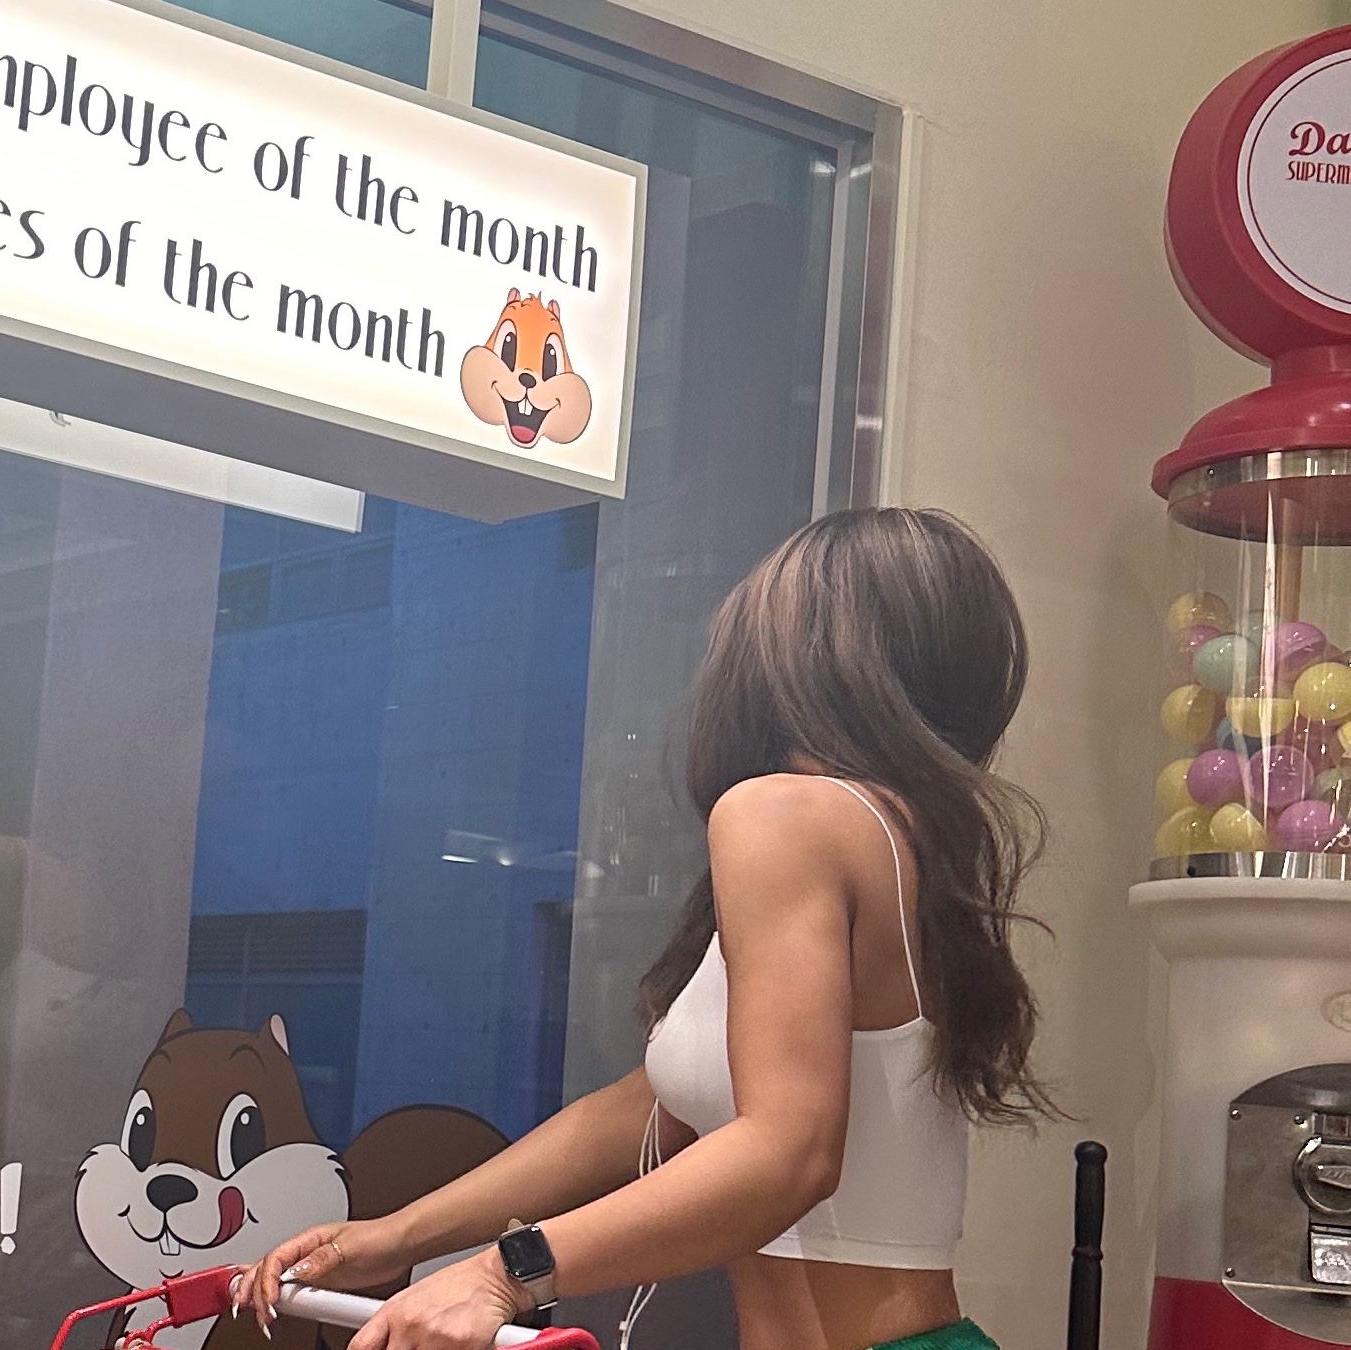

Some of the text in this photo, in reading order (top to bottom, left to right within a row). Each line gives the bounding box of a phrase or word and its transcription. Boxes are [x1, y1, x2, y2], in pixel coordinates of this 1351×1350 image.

[253, 135, 316, 200] of
[336, 154, 420, 235] the
[440, 198, 599, 293] month
[74, 220, 143, 288] of
[162, 237, 254, 322] the
[276, 284, 446, 379] month
